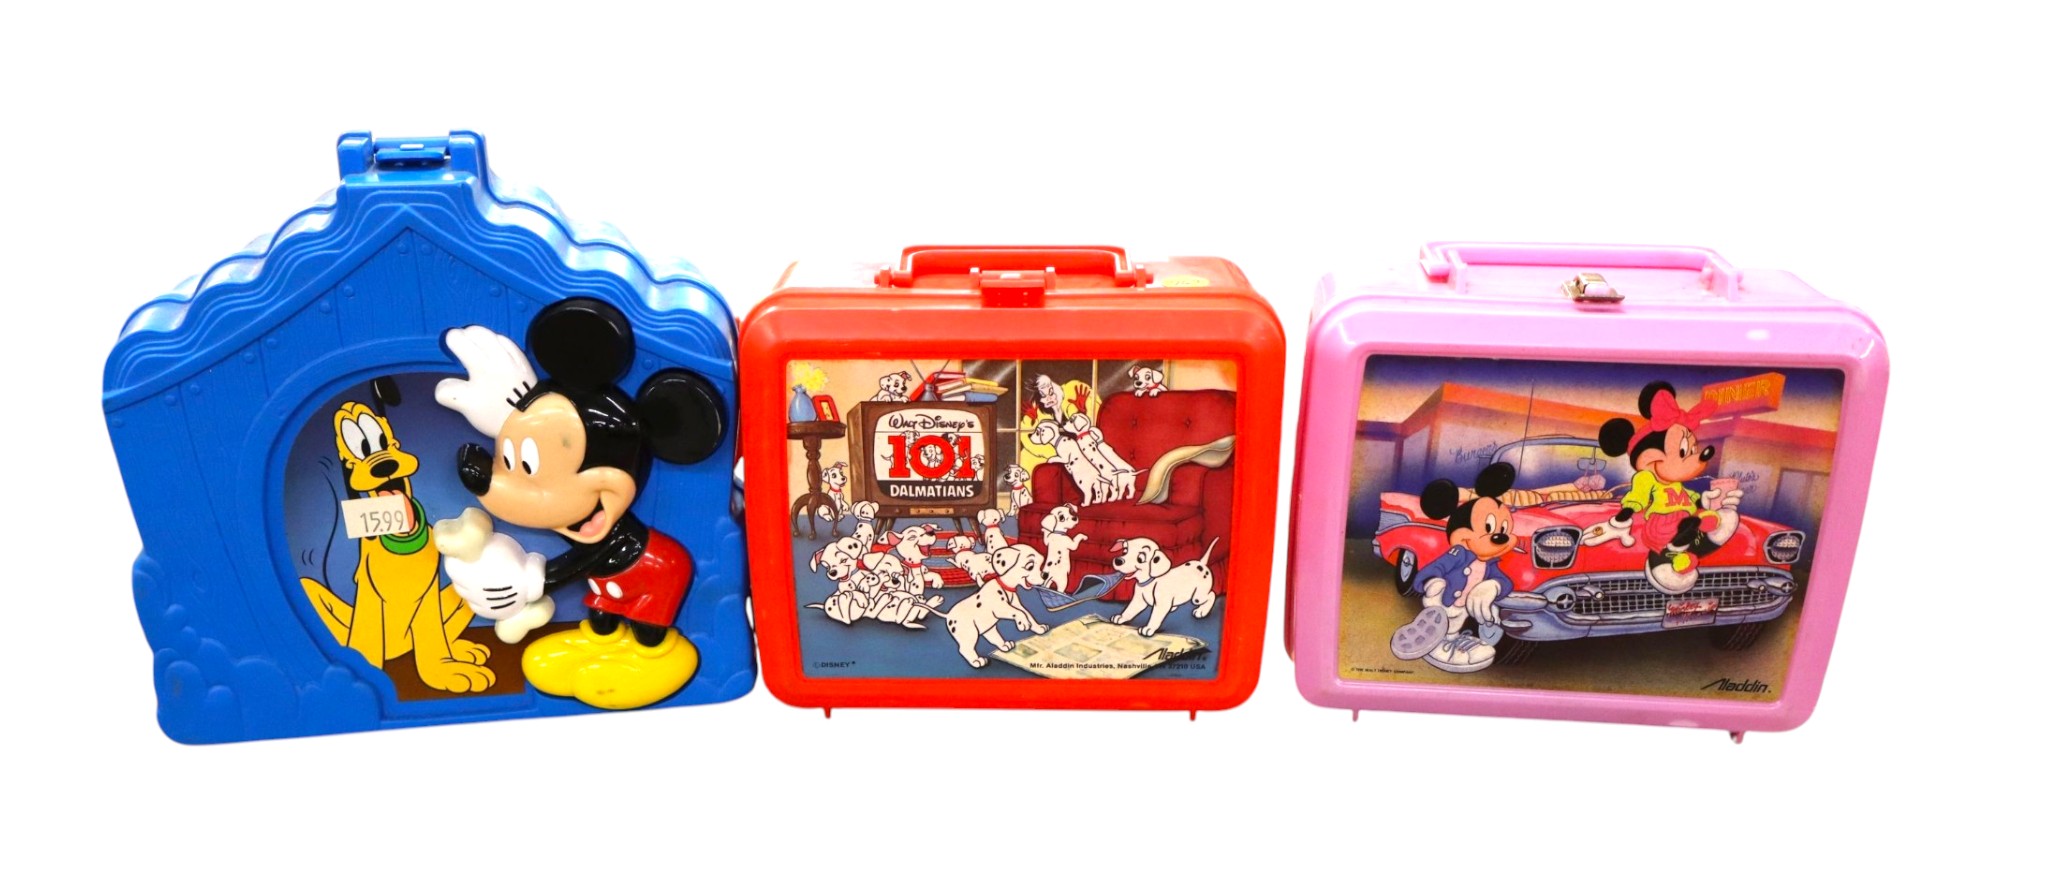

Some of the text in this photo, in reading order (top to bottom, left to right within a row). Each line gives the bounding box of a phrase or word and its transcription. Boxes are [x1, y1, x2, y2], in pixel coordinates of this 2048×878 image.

[888, 435, 975, 479] 101
[890, 484, 975, 498] DALMATIANS
[1663, 487, 1692, 507] M
[360, 509, 404, 533] 15.99
